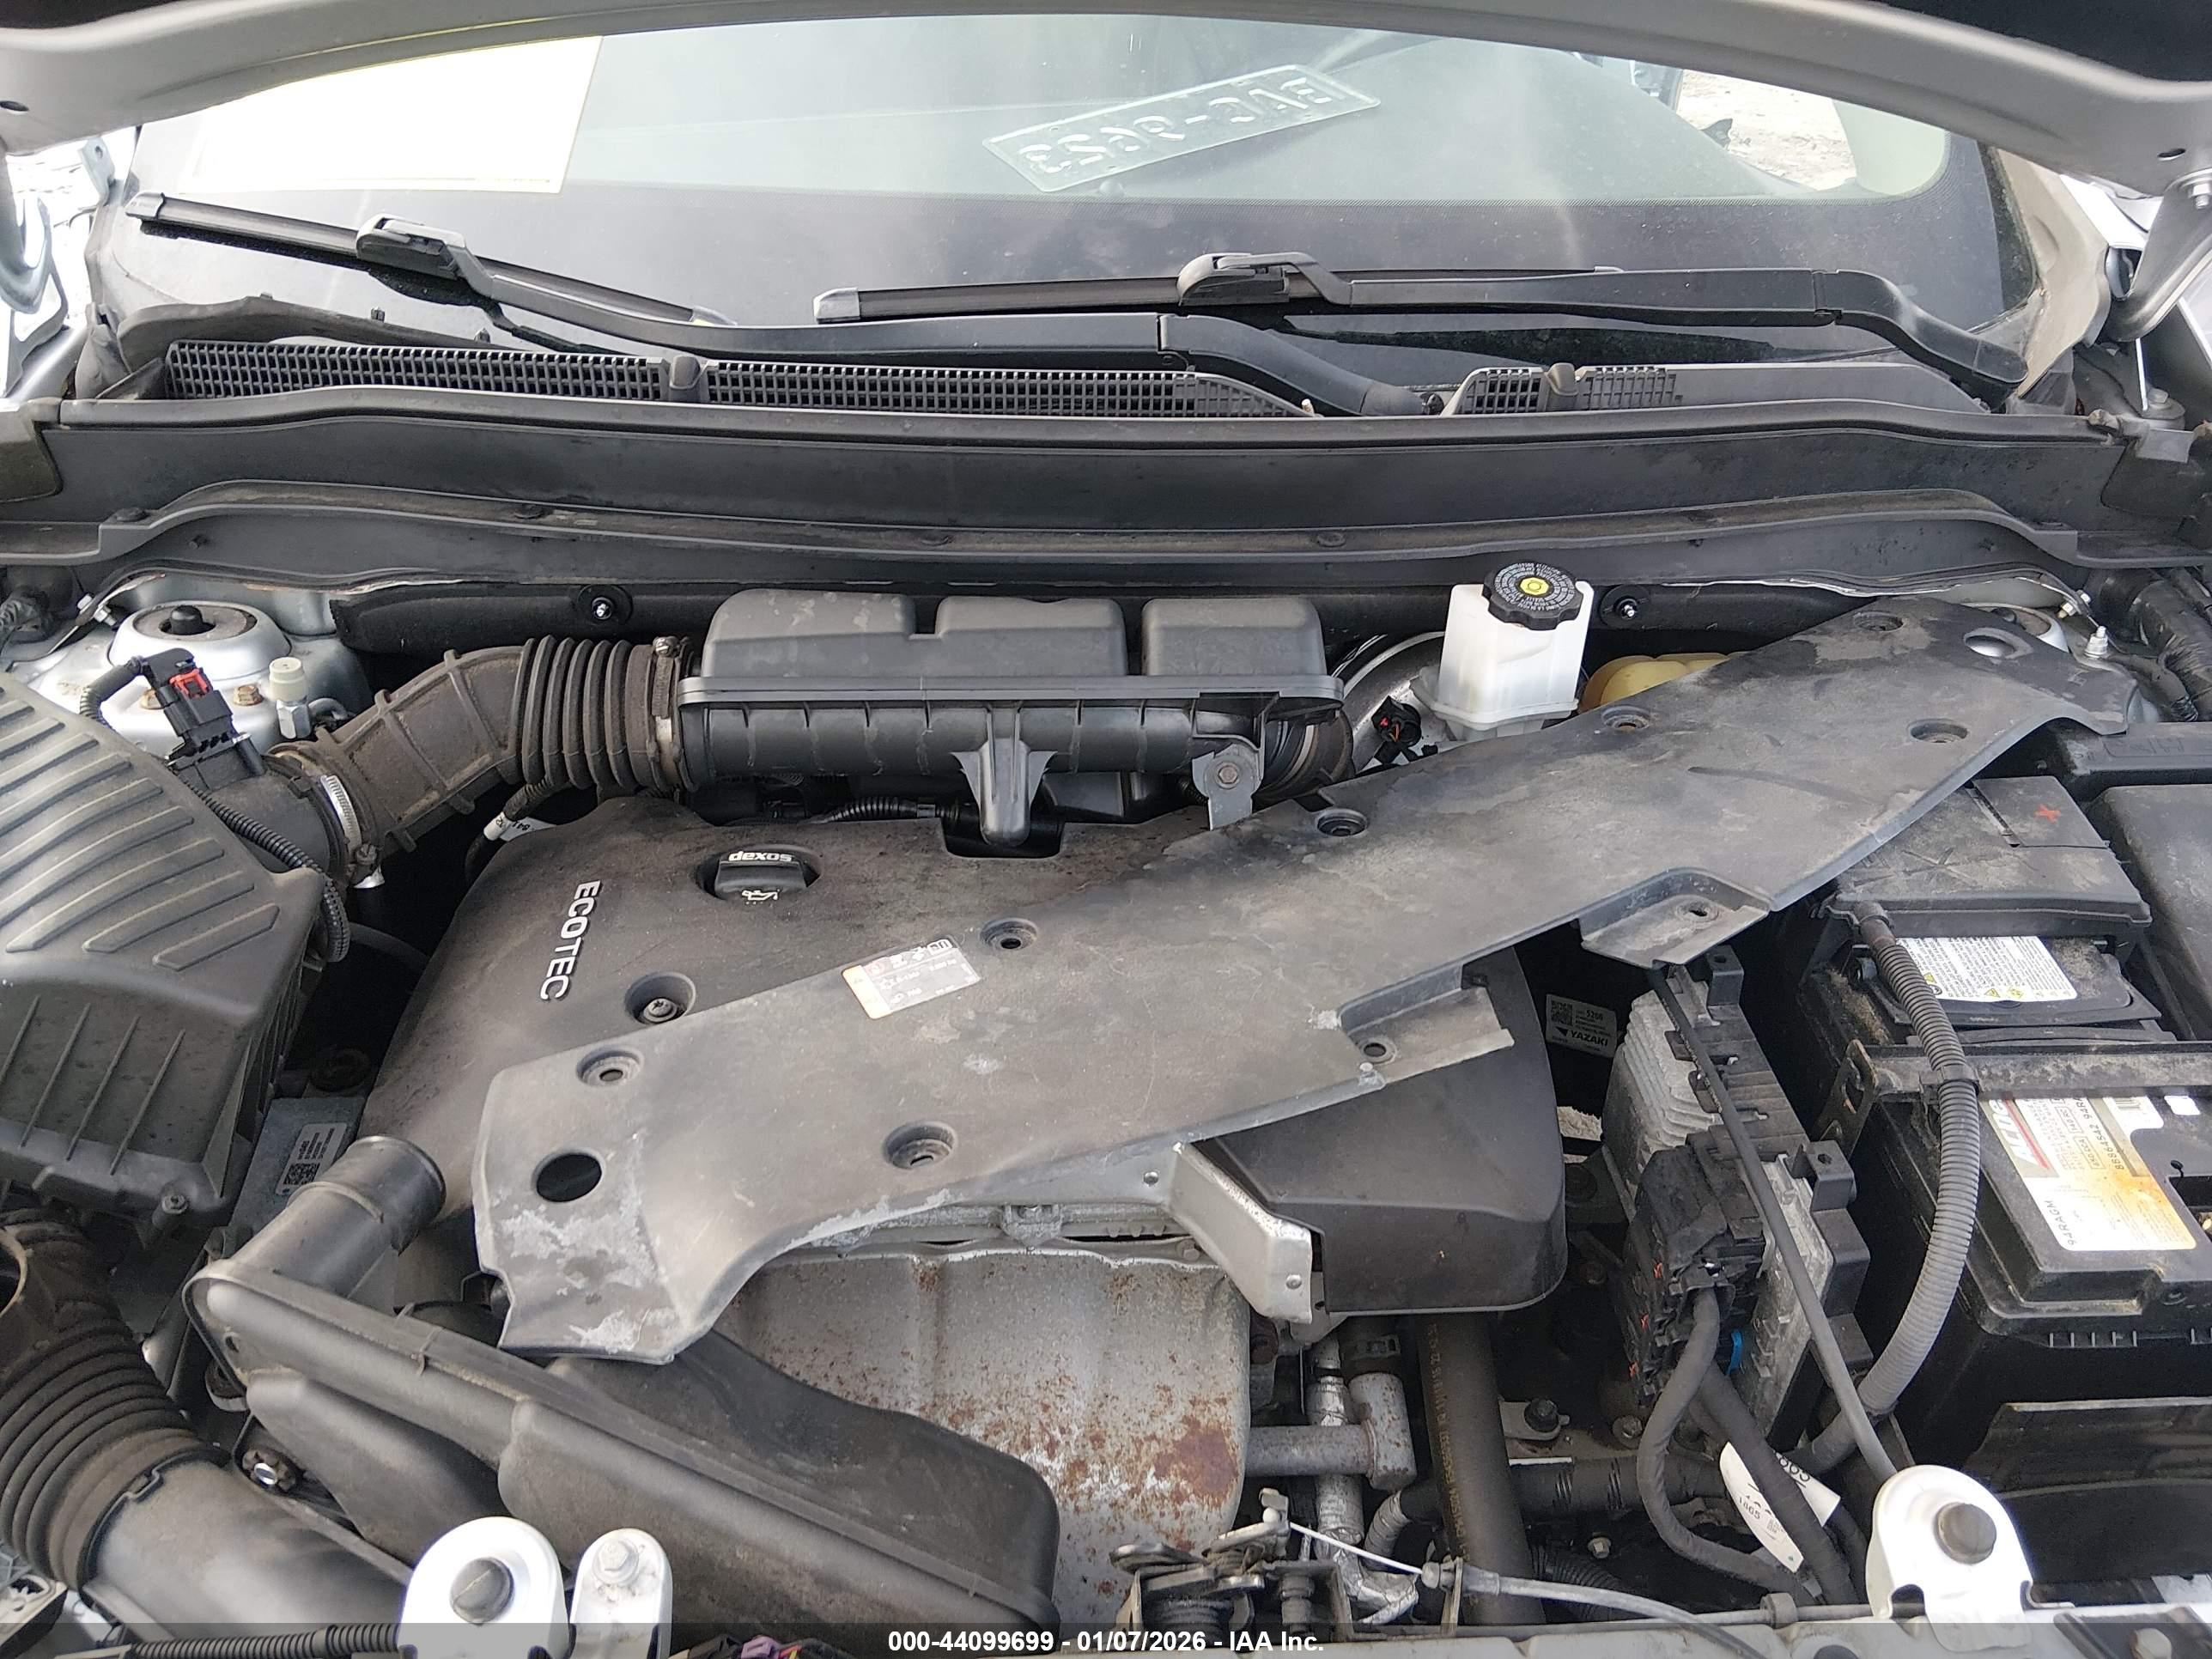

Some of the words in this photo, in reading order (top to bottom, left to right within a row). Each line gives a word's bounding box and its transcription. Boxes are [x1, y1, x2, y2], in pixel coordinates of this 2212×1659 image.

[727, 851, 794, 862] dexos
[540, 880, 601, 1001] ECOTEC
[1571, 1030, 1608, 1047] YAZAKI
[1987, 1099, 2039, 1165] ACDe
[2044, 1200, 2076, 1246] 94RAGM
